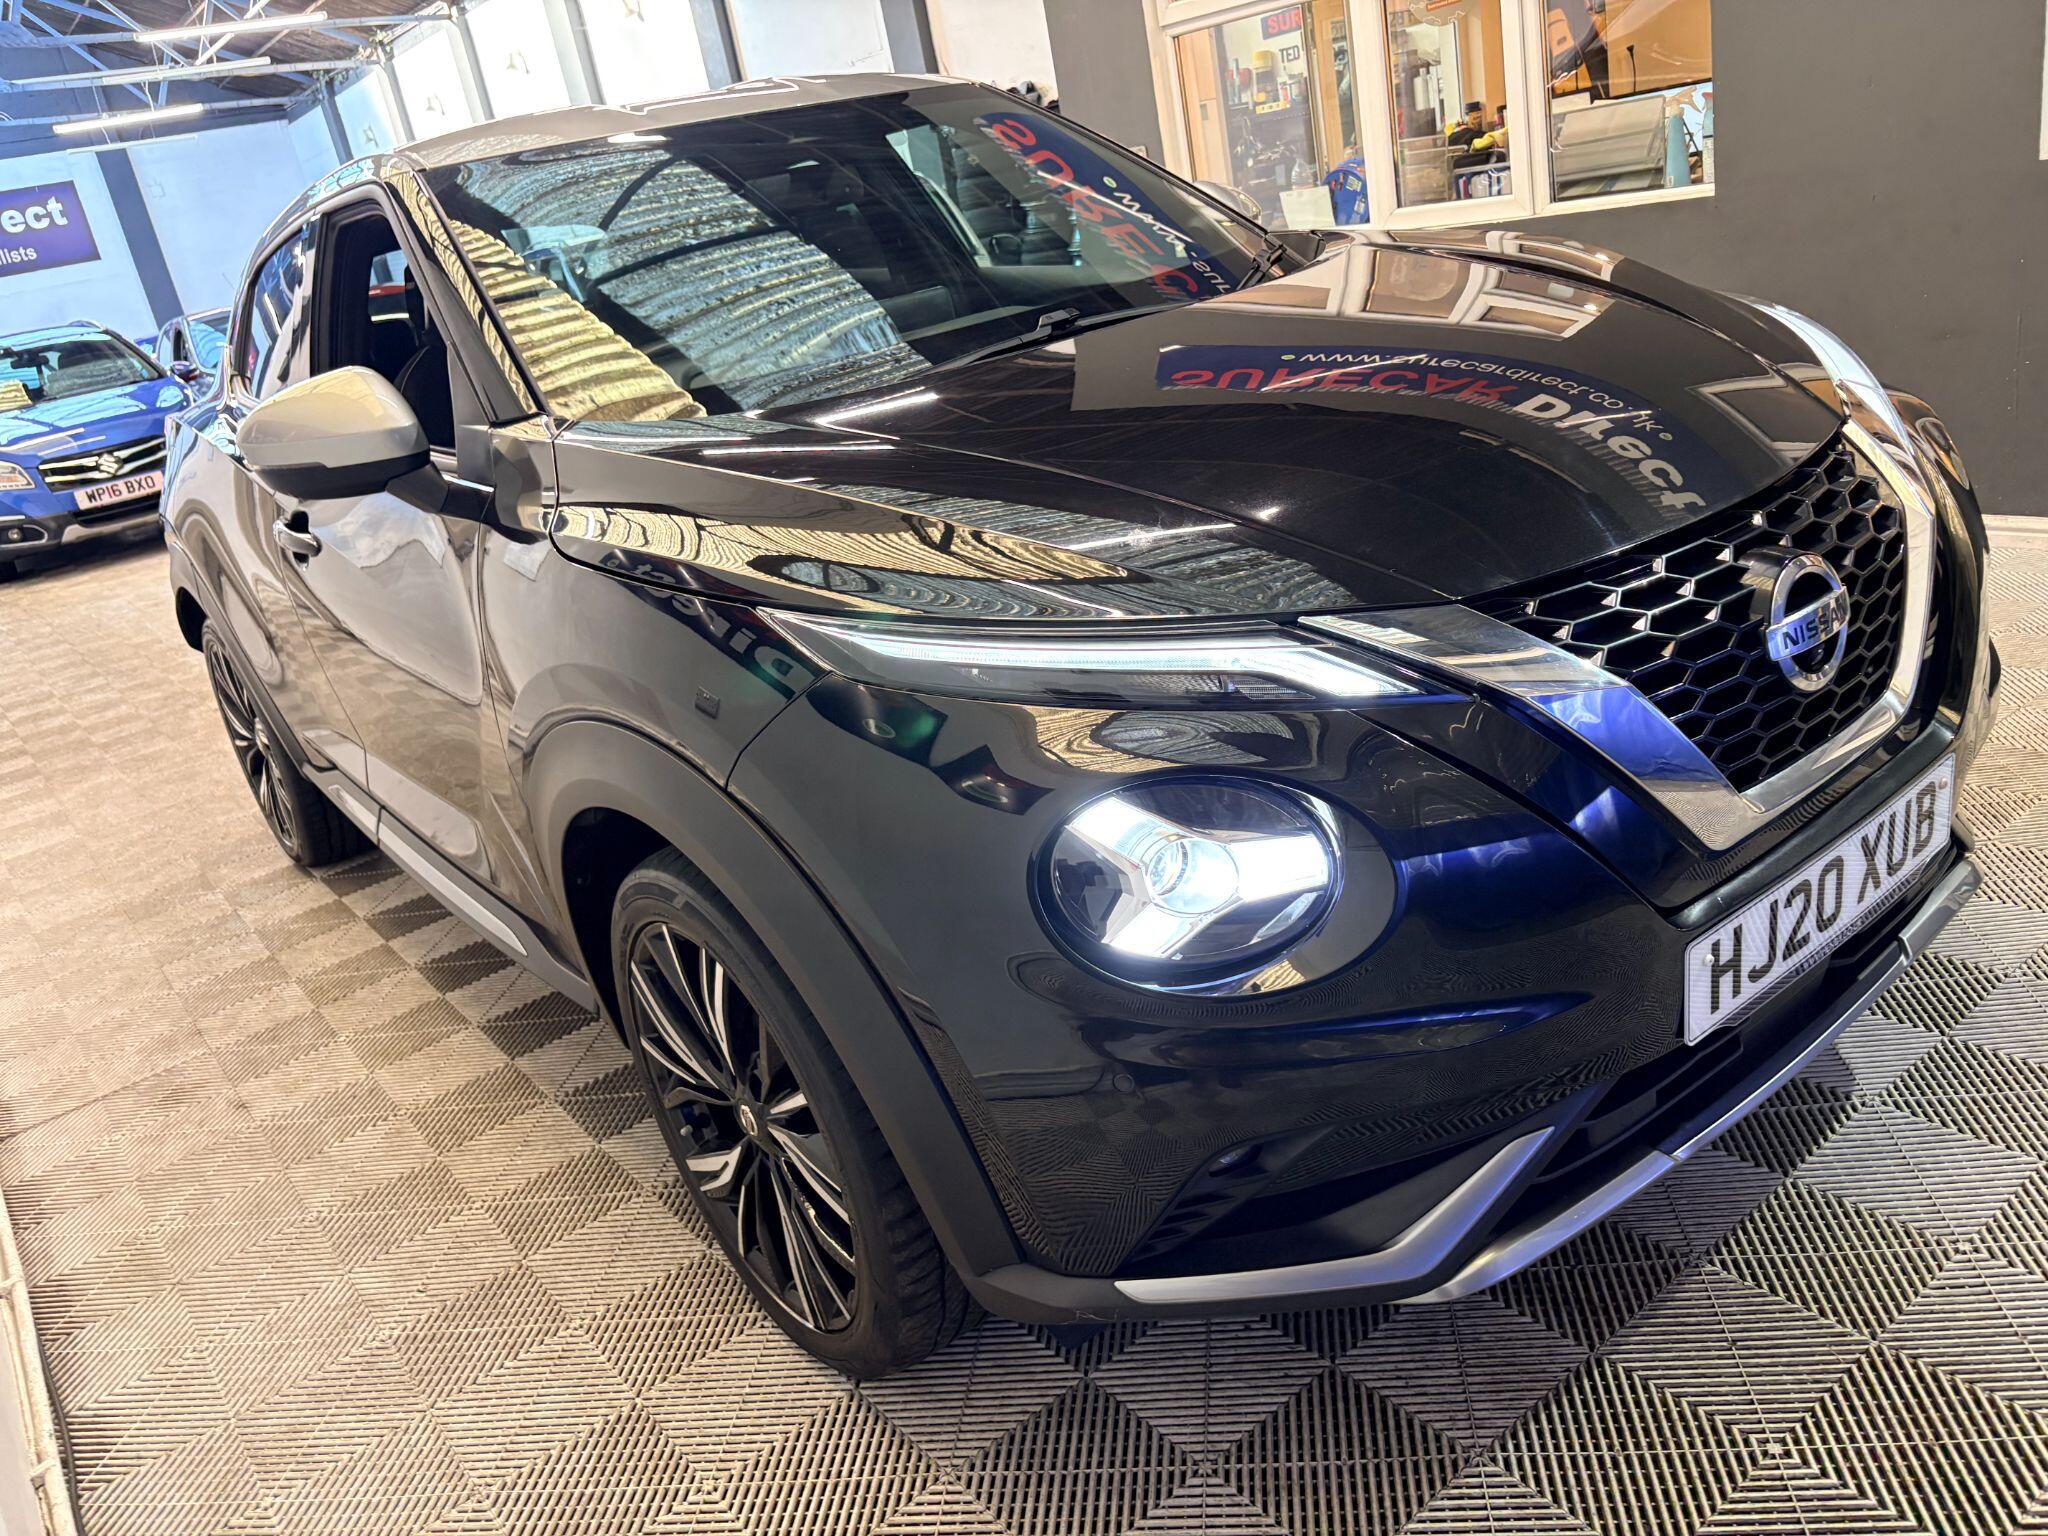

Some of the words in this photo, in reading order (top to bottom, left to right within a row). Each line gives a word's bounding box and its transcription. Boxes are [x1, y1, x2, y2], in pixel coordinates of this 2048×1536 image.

[0, 196, 68, 233] ect
[0, 246, 37, 265] lists
[86, 483, 123, 503] WP16
[1782, 598, 1847, 650] NISSAN
[1710, 855, 1844, 1015] HJ20
[1857, 781, 1937, 905] XUB
